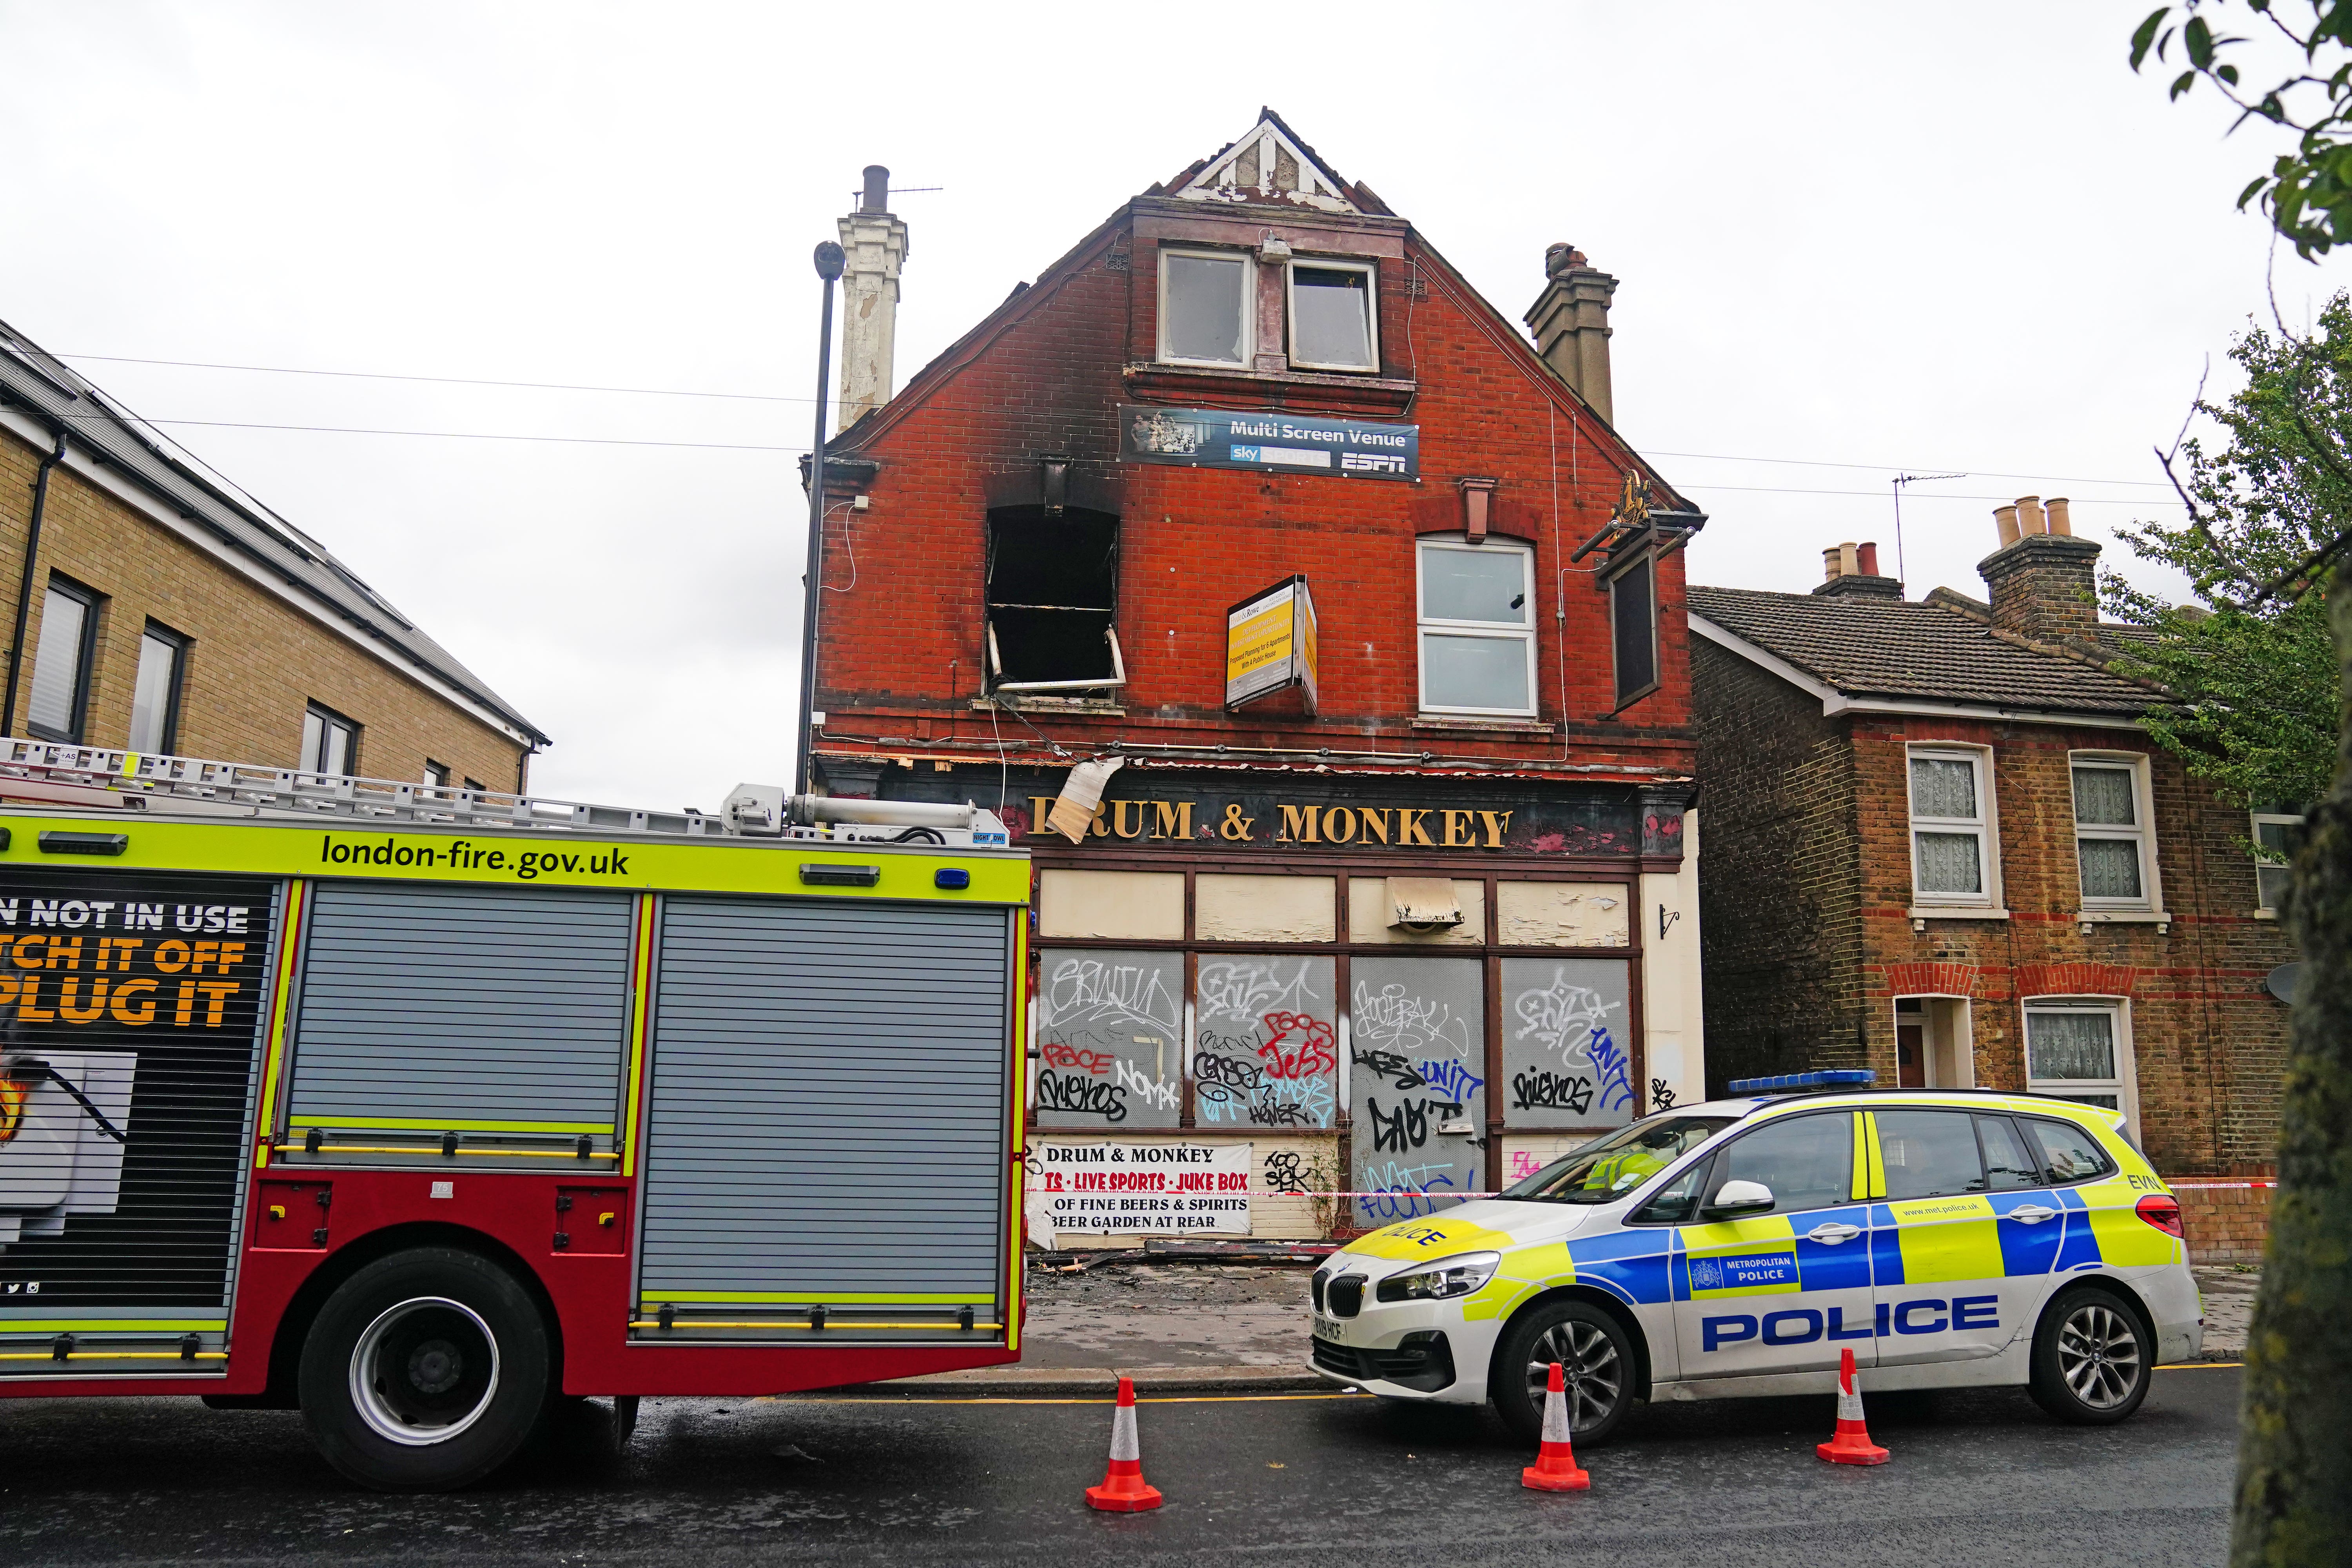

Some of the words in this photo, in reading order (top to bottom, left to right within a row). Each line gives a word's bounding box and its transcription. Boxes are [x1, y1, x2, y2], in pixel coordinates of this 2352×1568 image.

[1230, 421, 1278, 437] Multi
[1282, 424, 1344, 442] Screen
[1348, 430, 1406, 447] Venue
[1234, 446, 1258, 462] sky
[1341, 452, 1406, 473] ESPN
[1243, 615, 1277, 636] DEVELOPMENT
[1230, 632, 1258, 651] INVESTMENT
[1230, 653, 1245, 665] Proposed
[1245, 646, 1260, 658] Planning
[1269, 633, 1290, 648] Apartments
[1253, 654, 1264, 664] Public
[1265, 650, 1276, 659] House
[1220, 804, 1255, 841] &
[1276, 805, 1513, 848] MONKEY
[322, 835, 631, 879] london-fire.gov.uk
[30, 899, 115, 929] NOT
[124, 903, 164, 931] IN
[176, 905, 249, 933] USE
[96, 938, 143, 971] IT
[154, 940, 246, 974] OFF
[175, 981, 240, 1027] IT
[1047, 1148, 1105, 1162] DRUM
[1111, 1149, 1125, 1162] &
[1131, 1149, 1214, 1163] MONKEY
[1075, 1172, 1107, 1189] LIVE
[1109, 1172, 1165, 1190] SPORTS
[1176, 1172, 1214, 1191] JUKE
[1218, 1172, 1248, 1191] BOX
[2127, 1175, 2161, 1190] EVN
[1055, 1199, 1075, 1210] OF
[1080, 1199, 1116, 1210] FINE
[1120, 1199, 1169, 1210] BEERS
[1173, 1199, 1185, 1210] &
[1189, 1199, 1247, 1210] SPIRITS
[1903, 1203, 1980, 1217] www.met.police.uk
[1091, 1216, 1152, 1227] GARDEN
[1155, 1216, 1173, 1227] AT
[1178, 1216, 1215, 1227] REAR
[1727, 1257, 1791, 1270] METROPOLITAN
[1739, 1269, 1785, 1281] POLICE
[1327, 1321, 1341, 1341] HCF
[1702, 1295, 2000, 1352] POLICE
